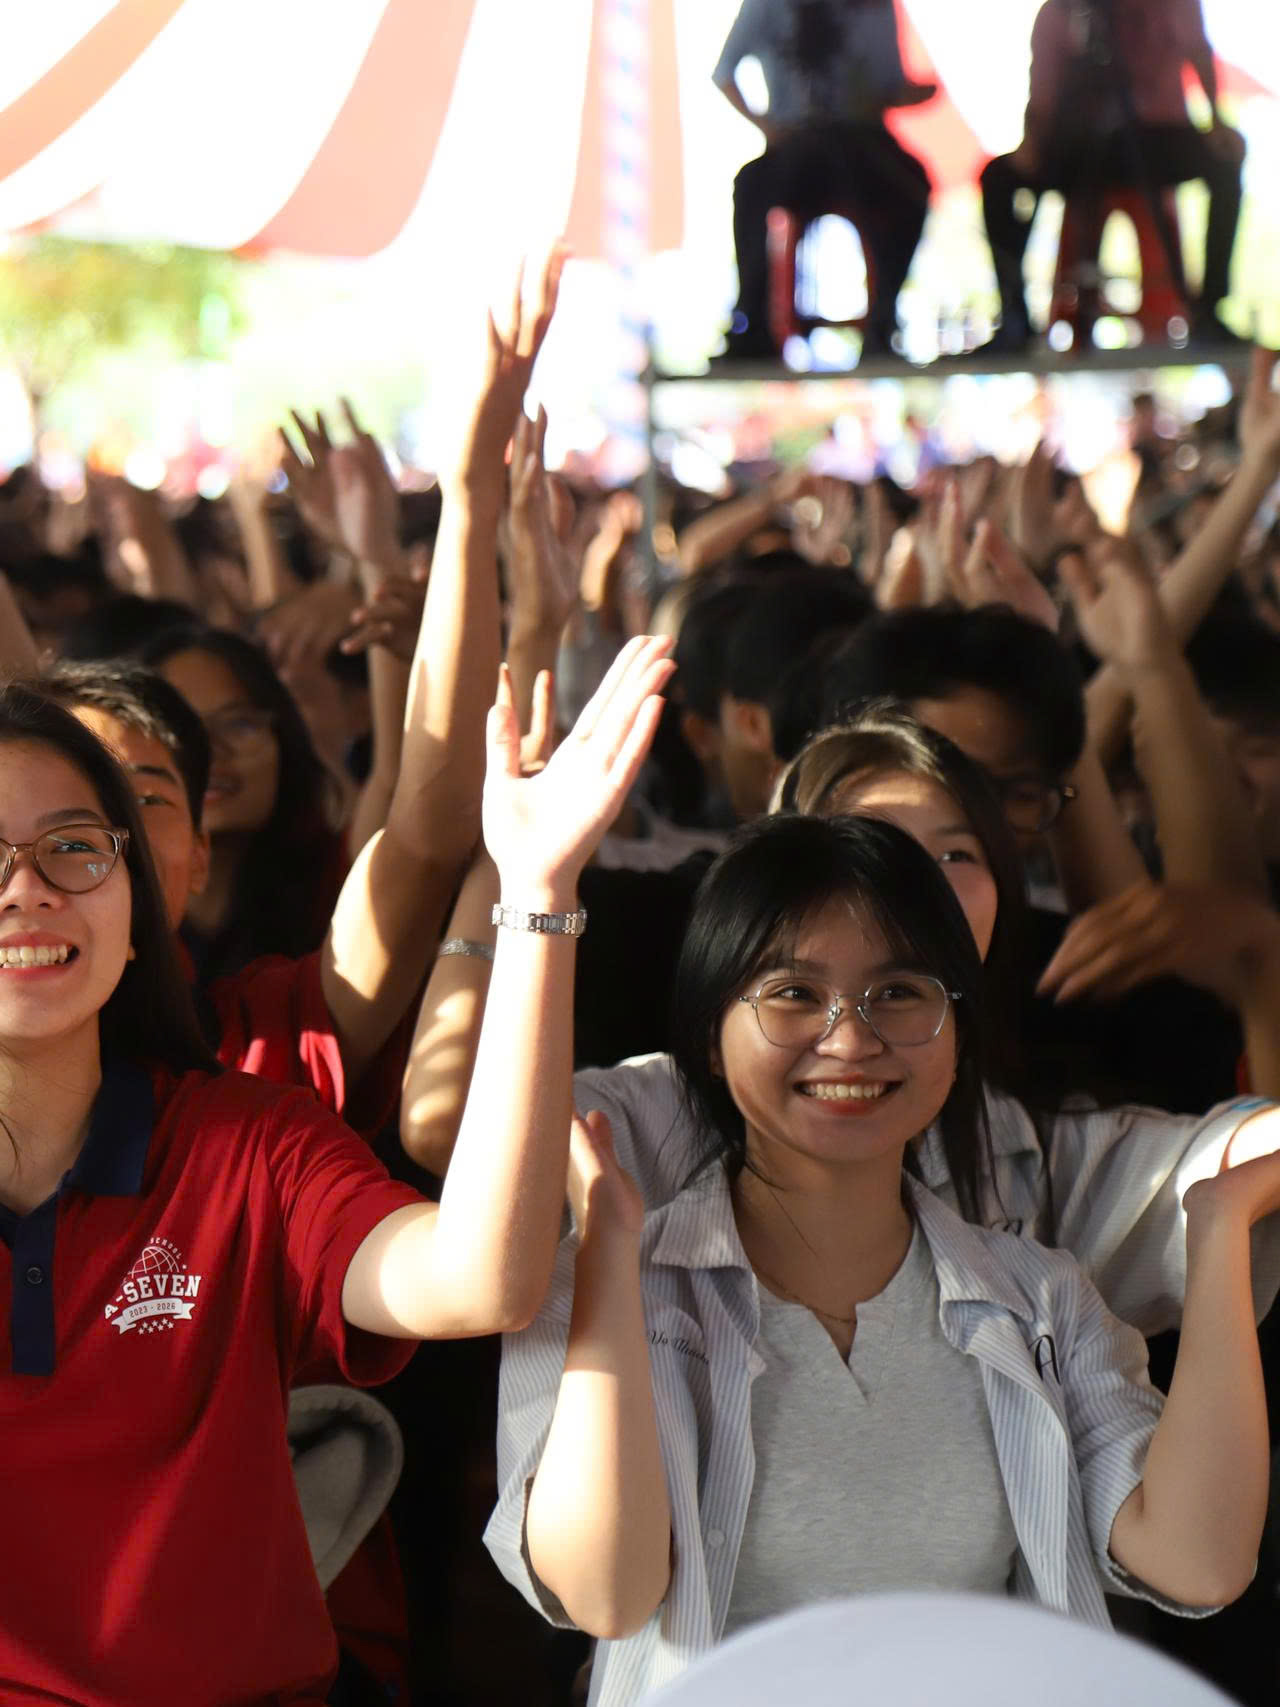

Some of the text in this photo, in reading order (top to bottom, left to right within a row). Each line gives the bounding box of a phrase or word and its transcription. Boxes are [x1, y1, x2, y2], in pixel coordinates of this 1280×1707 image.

[150, 1237, 181, 1259] SCHOOL
[104, 1274, 201, 1319] A-SEVEN
[128, 1305, 148, 1318] 2023
[157, 1302, 176, 1312] 2026
